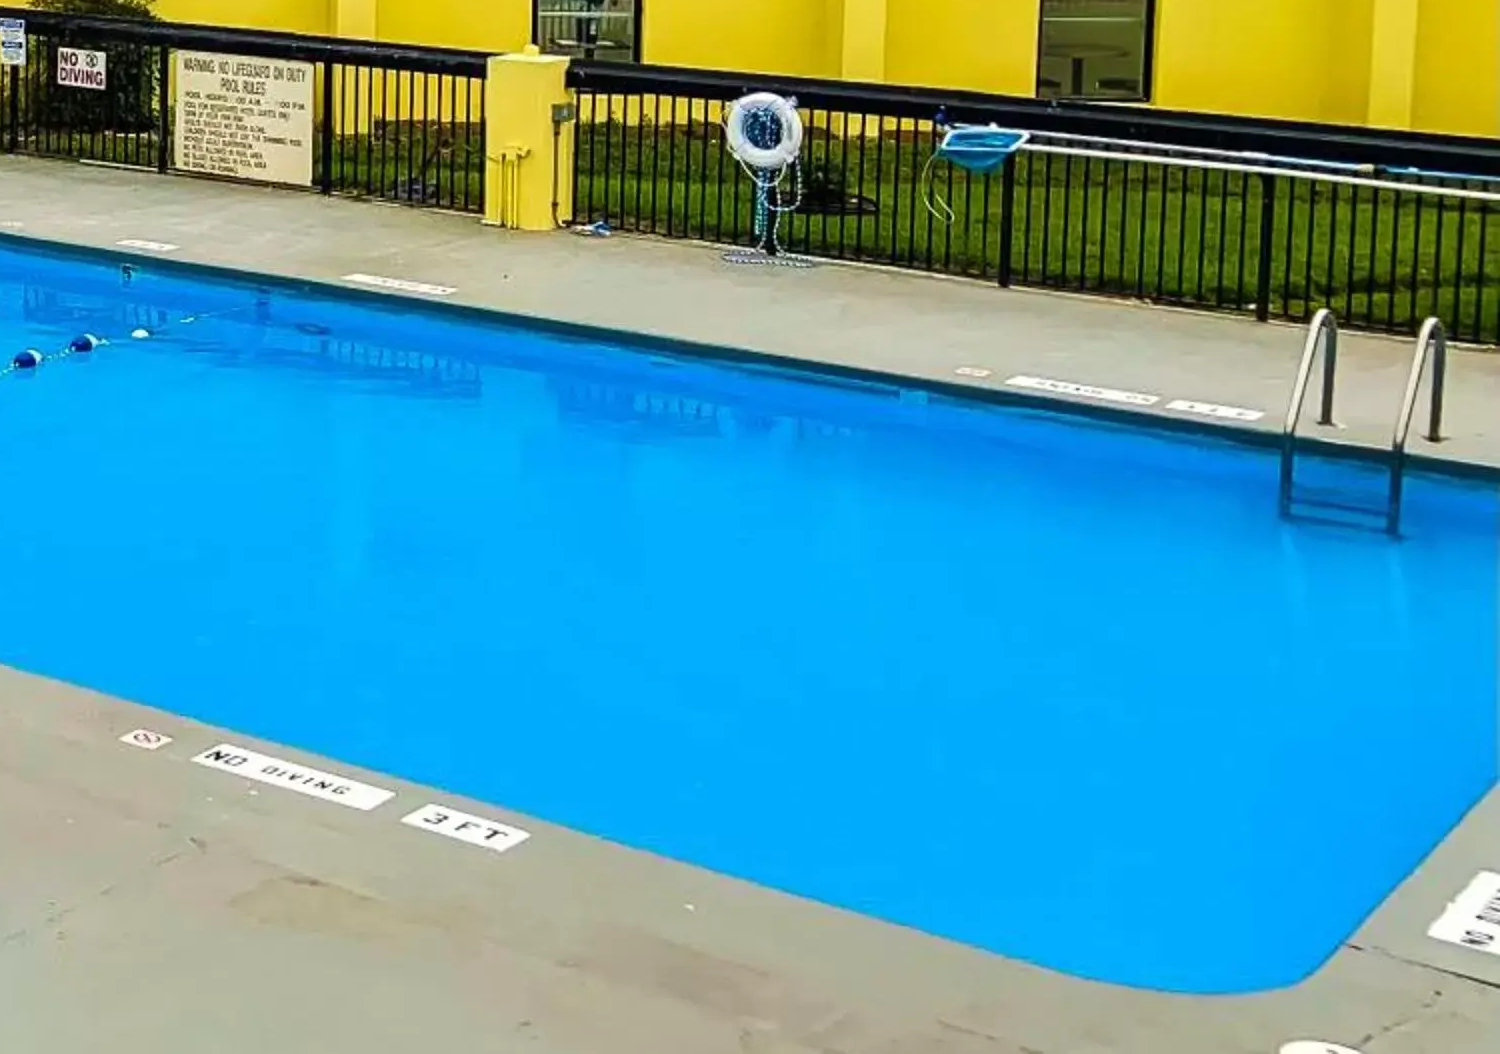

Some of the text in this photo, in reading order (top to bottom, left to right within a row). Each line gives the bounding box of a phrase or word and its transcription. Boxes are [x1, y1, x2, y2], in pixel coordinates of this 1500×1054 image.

[60, 51, 78, 67] NO
[60, 67, 103, 87] DIVING
[218, 60, 230, 75] NO
[232, 62, 270, 79] LIFEGUARD
[273, 66, 285, 80] ON
[286, 67, 306, 82] DUTY
[220, 77, 266, 96] POOL RULES
[204, 749, 351, 796] NO DIVING
